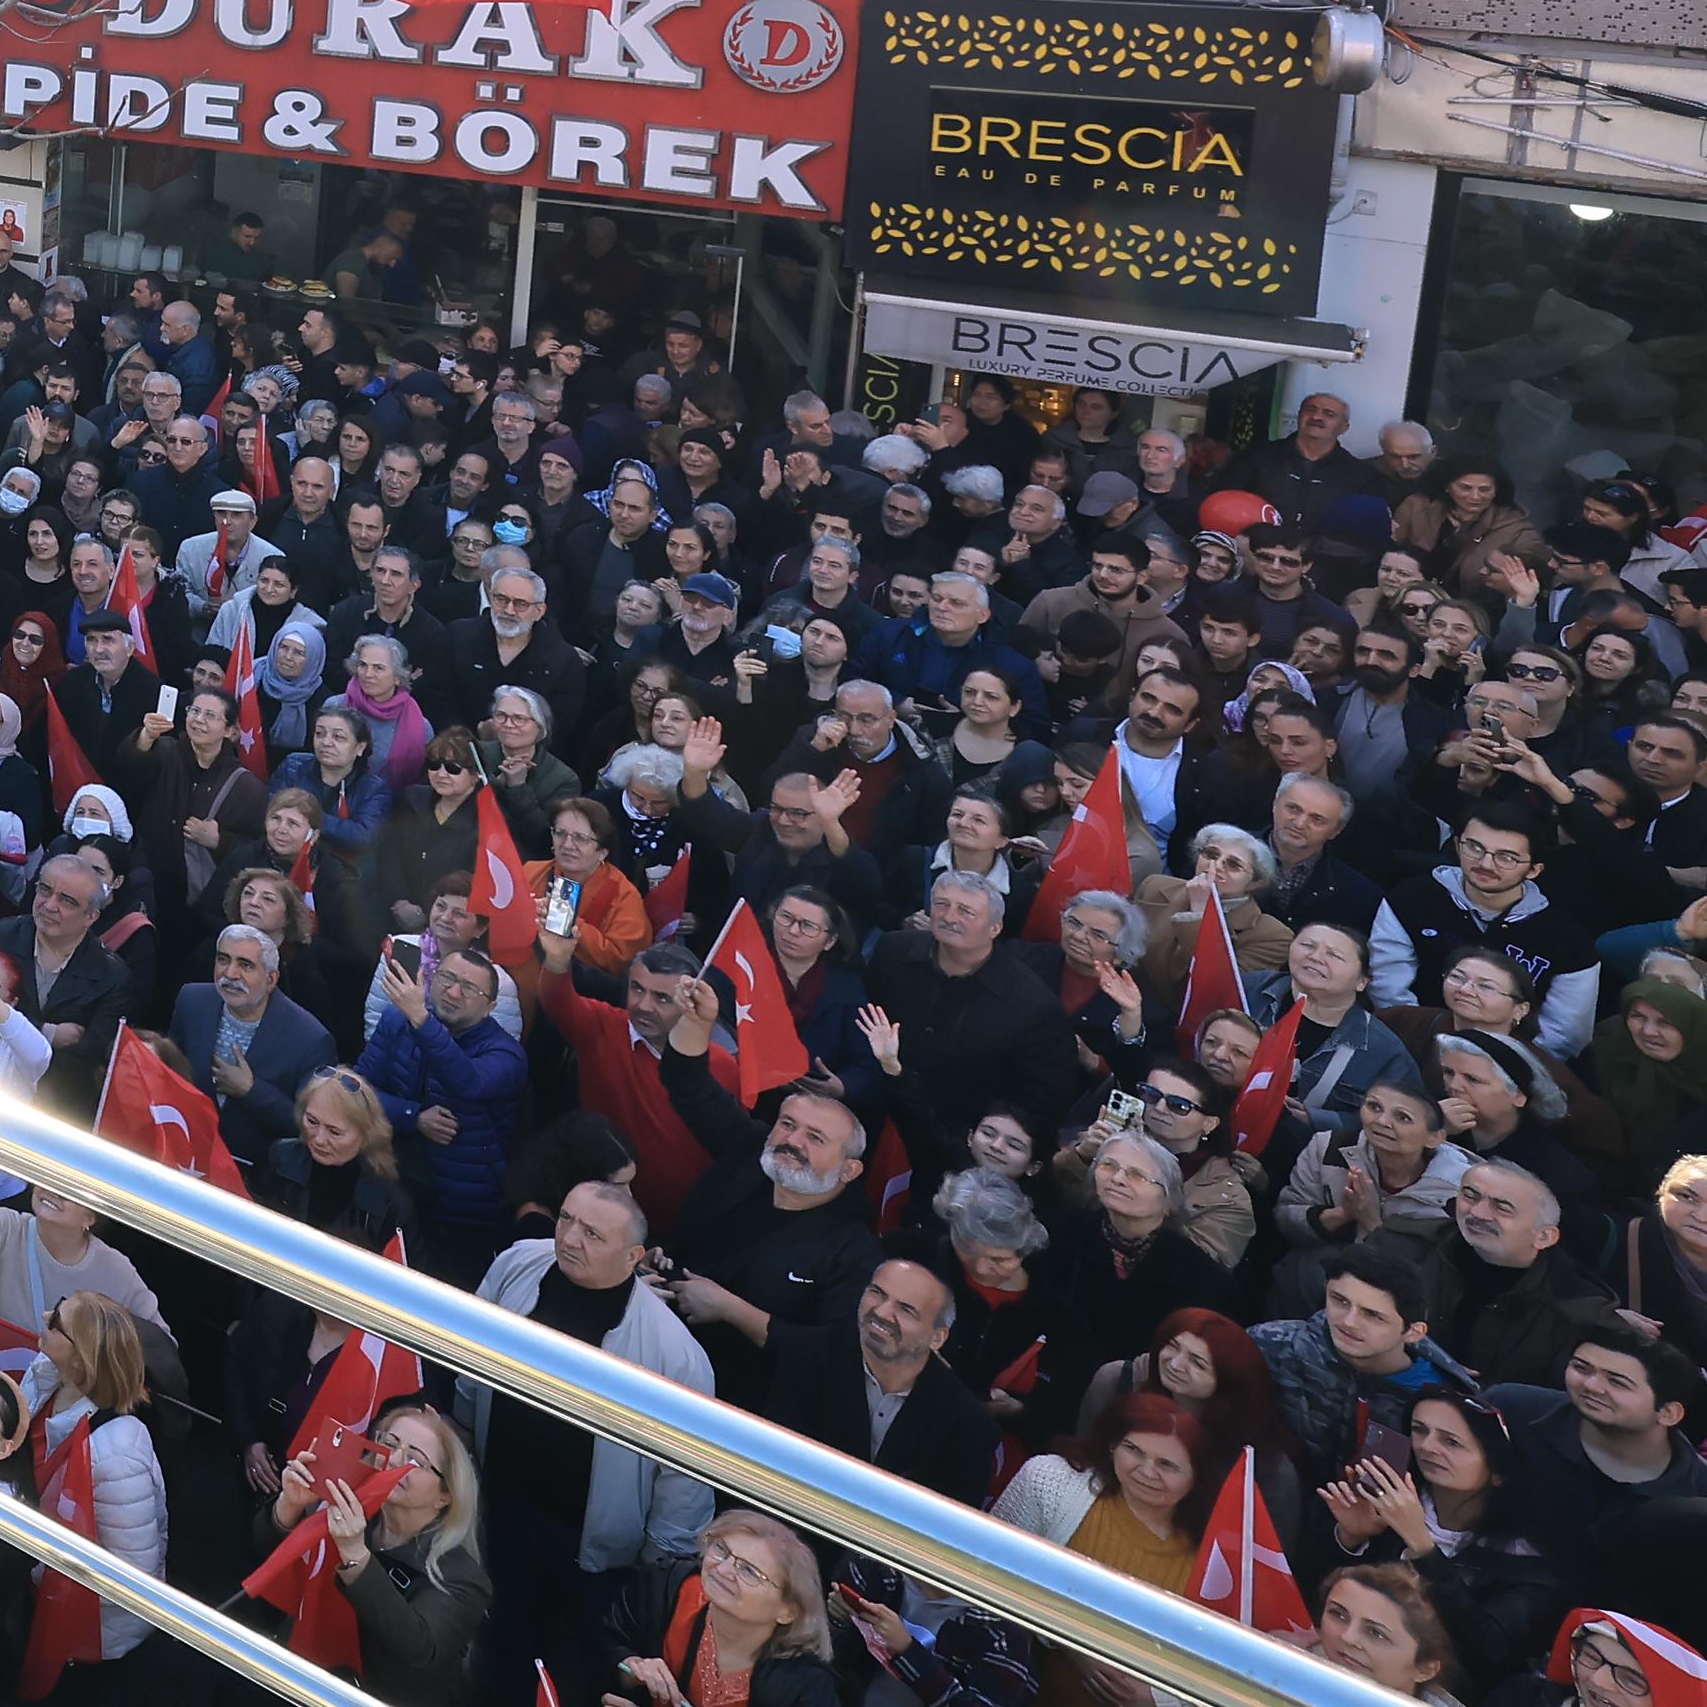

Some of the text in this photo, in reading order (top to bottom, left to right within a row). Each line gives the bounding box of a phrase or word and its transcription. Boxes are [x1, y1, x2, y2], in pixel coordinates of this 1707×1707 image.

[2, 44, 834, 212] PİDE & BÖREK
[930, 113, 1244, 177] BRESCIA
[934, 165, 1236, 202] EAU DE PARFUM
[952, 317, 1240, 384] BRESCIA
[969, 359, 1032, 376] LUXURY
[1037, 368, 1110, 388] PERFUME
